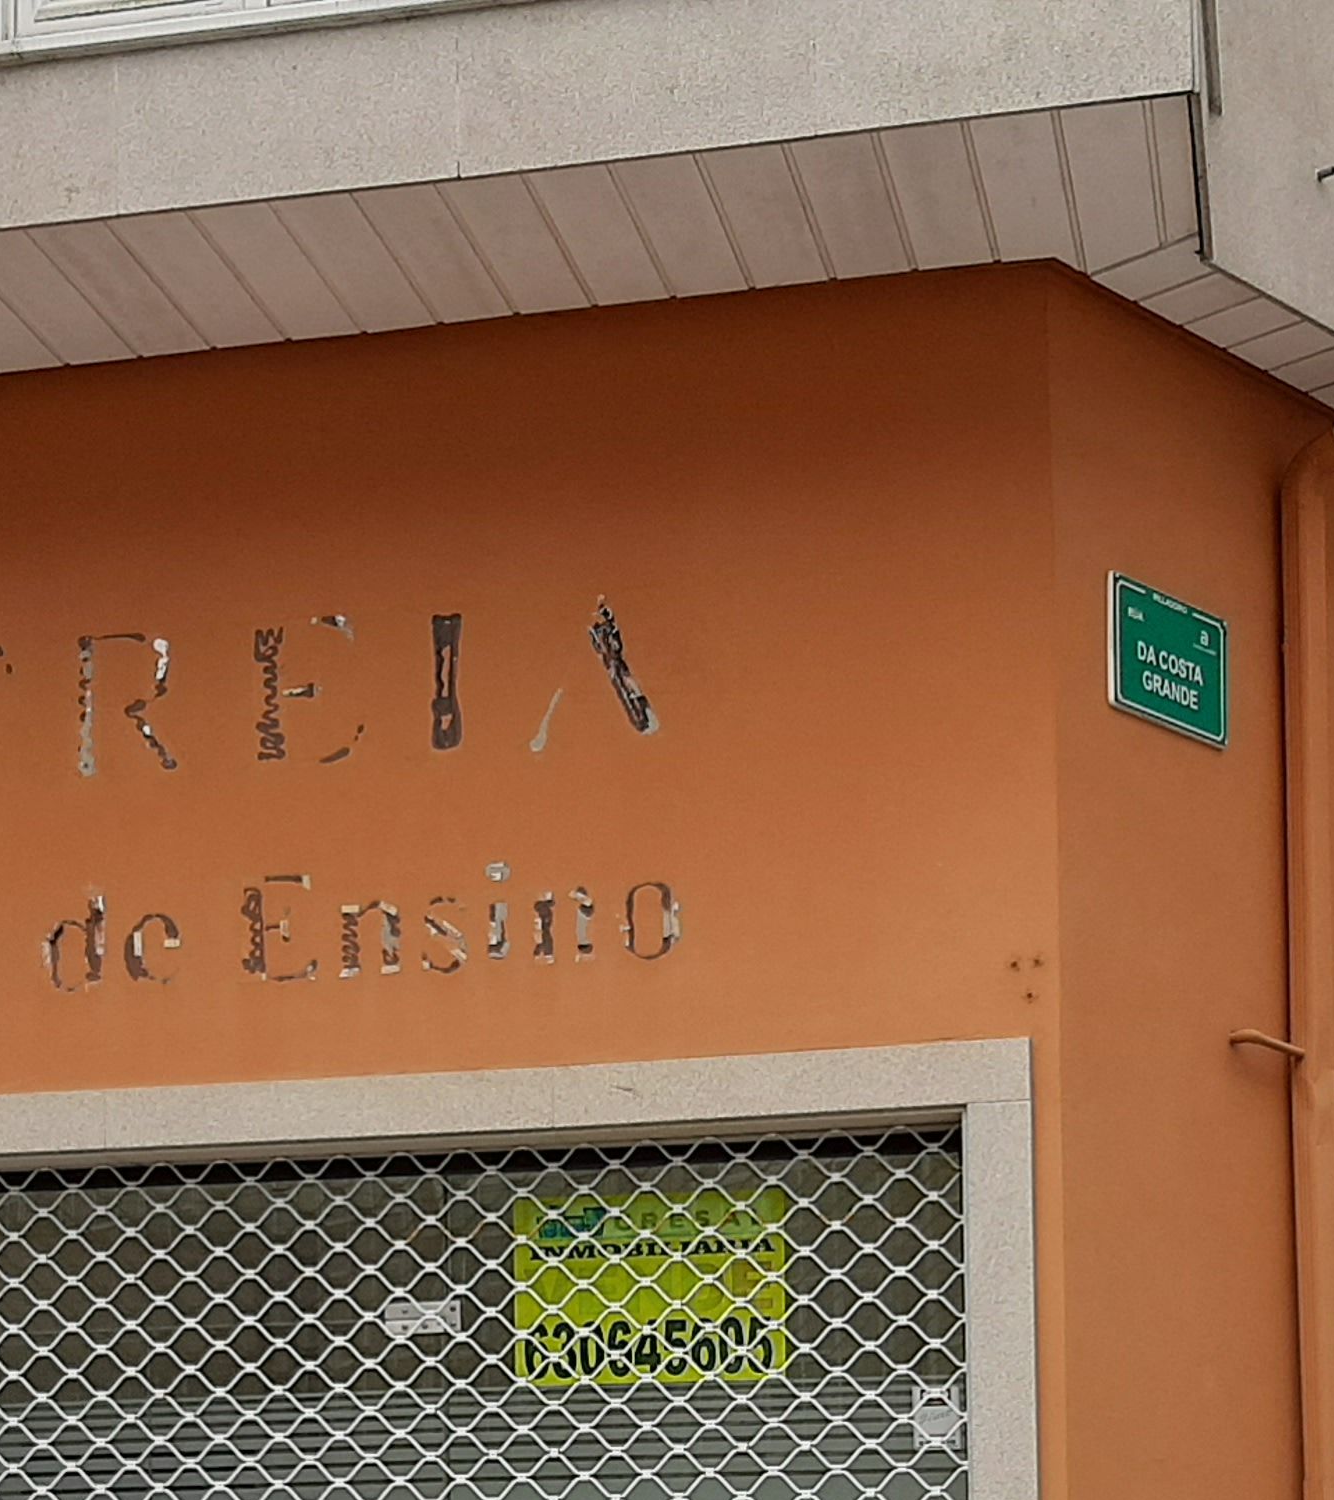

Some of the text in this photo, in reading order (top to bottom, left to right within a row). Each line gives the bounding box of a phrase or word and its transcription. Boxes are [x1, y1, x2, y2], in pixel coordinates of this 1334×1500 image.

[1137, 640, 1157, 666] DA
[1159, 650, 1204, 687] COSTA
[1142, 670, 1199, 710] GRANDE
[43, 885, 181, 994] de
[241, 860, 683, 983] Ensino
[525, 1316, 773, 1379] 630645605
